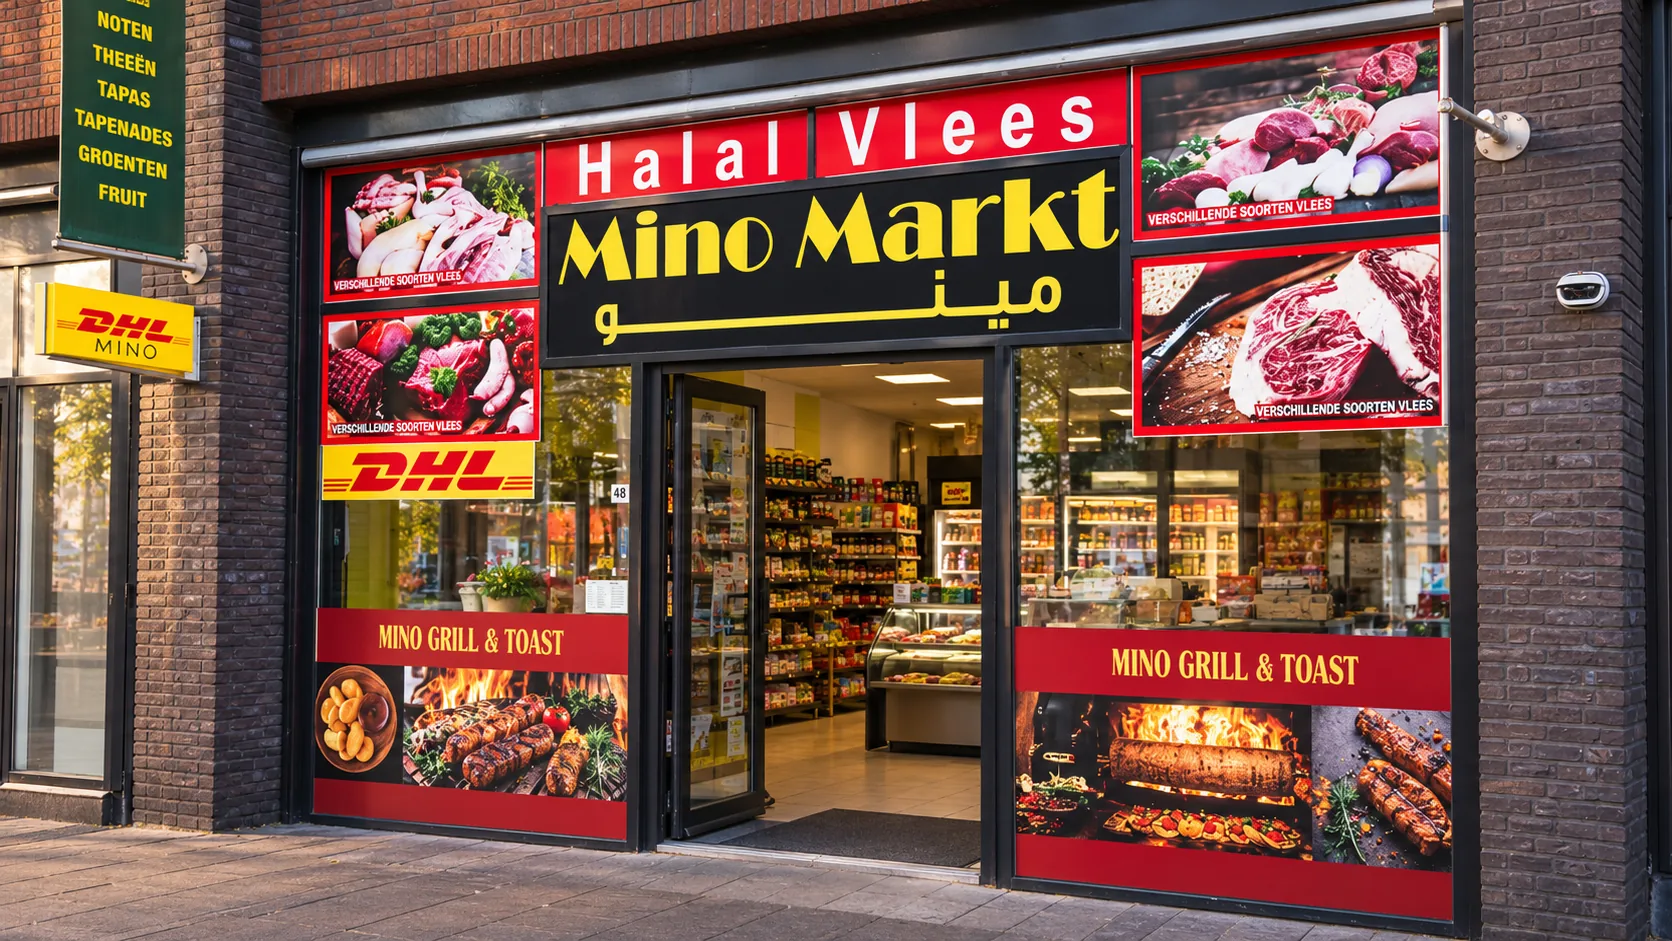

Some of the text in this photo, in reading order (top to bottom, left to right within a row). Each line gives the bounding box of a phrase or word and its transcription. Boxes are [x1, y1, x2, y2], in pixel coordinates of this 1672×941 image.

[97, 10, 153, 42] NOTEN
[92, 44, 156, 77] THEEËN
[97, 79, 151, 109] TAPAS
[75, 108, 173, 148] TAPENADES
[578, 95, 1095, 196] Halal Vlees
[78, 145, 168, 180] GROENTEN
[98, 183, 148, 208] FRUIT
[558, 168, 1120, 285] Mino Markt
[1148, 198, 1332, 226] VERSCHILLENDE SOORTEN VLEES
[333, 276, 395, 291] VERSCHILLENDE
[396, 272, 435, 286] SOORTEN
[76, 307, 174, 345] DHL
[94, 337, 157, 361] MINO
[1256, 398, 1433, 417] VERSCHILLENDE SOORTEN VLEES
[331, 420, 462, 435] VERSCHILLENDE SOORTEN VLEES
[350, 450, 506, 492] DHL
[613, 487, 626, 499] 48
[378, 624, 565, 656] MINO GRILL & TOAST
[1111, 648, 1360, 686] MINO GRILL & TOAST
